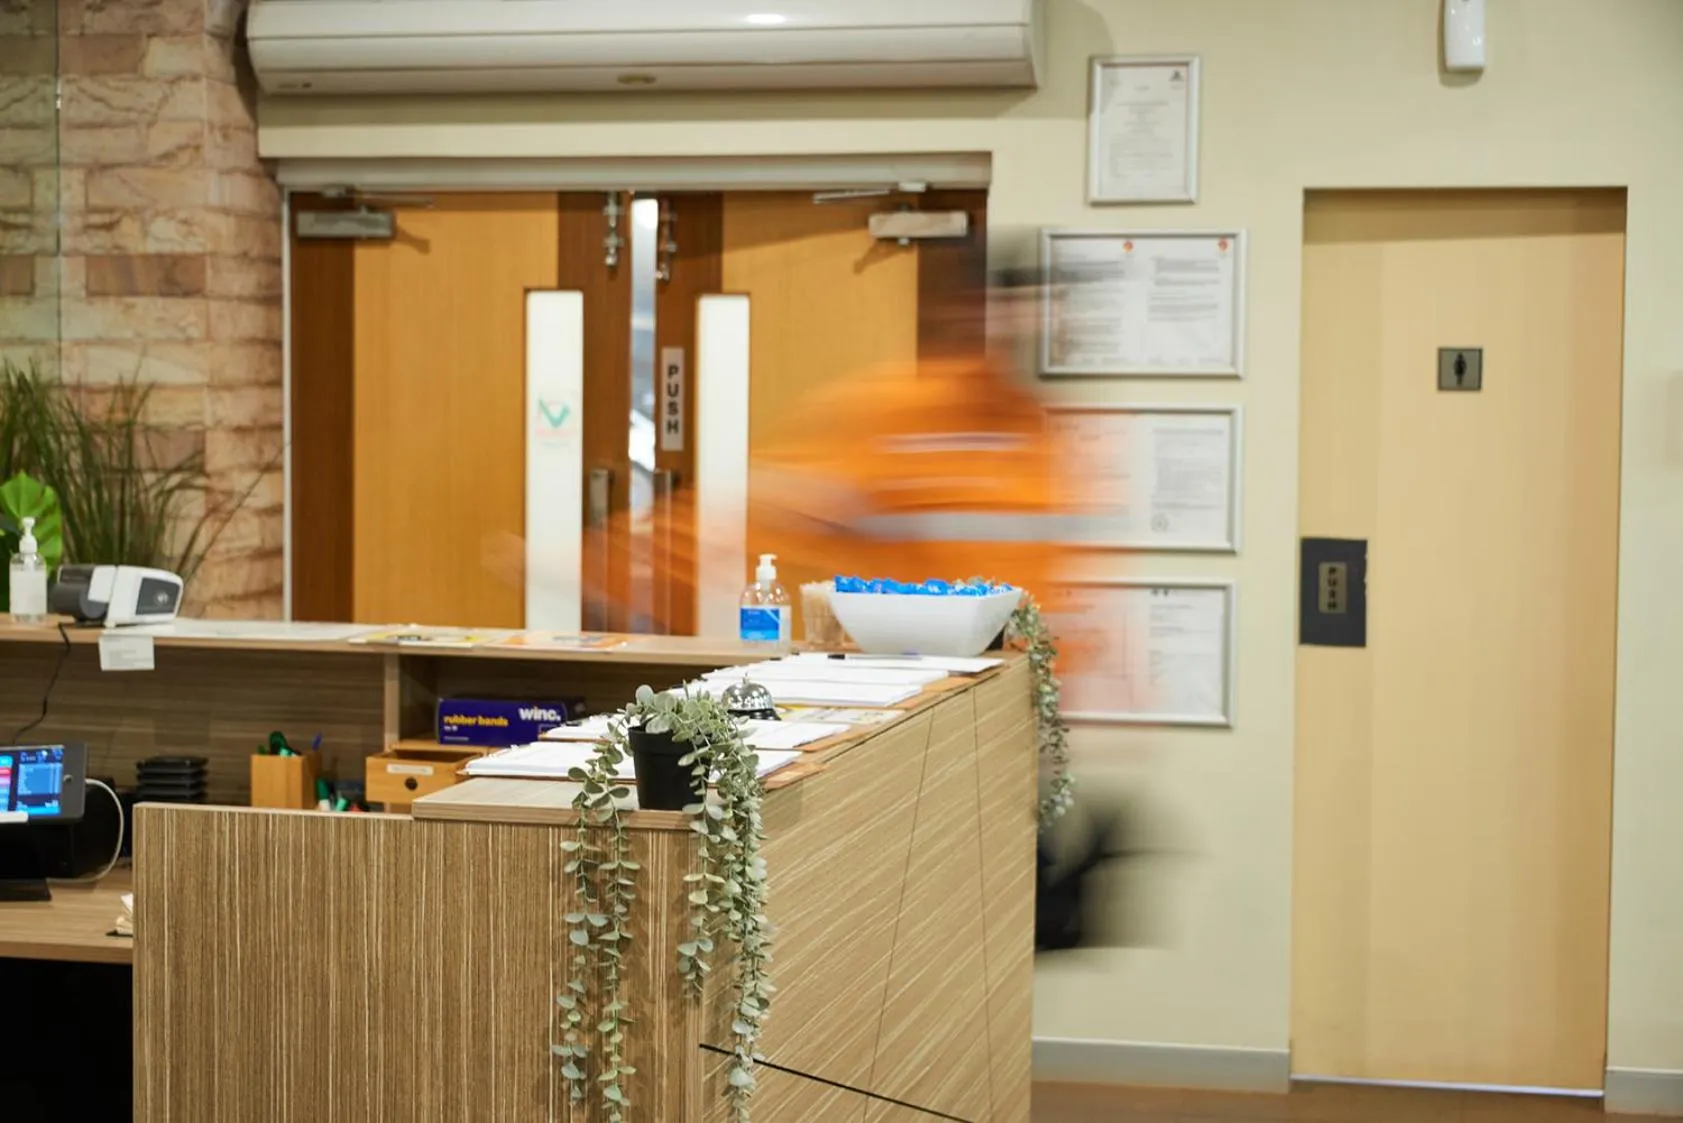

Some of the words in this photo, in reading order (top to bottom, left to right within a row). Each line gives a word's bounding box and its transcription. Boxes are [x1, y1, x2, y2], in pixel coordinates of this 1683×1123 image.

[666, 365, 680, 435] PUSH
[443, 714, 477, 726] rubber
[478, 715, 509, 727] bands
